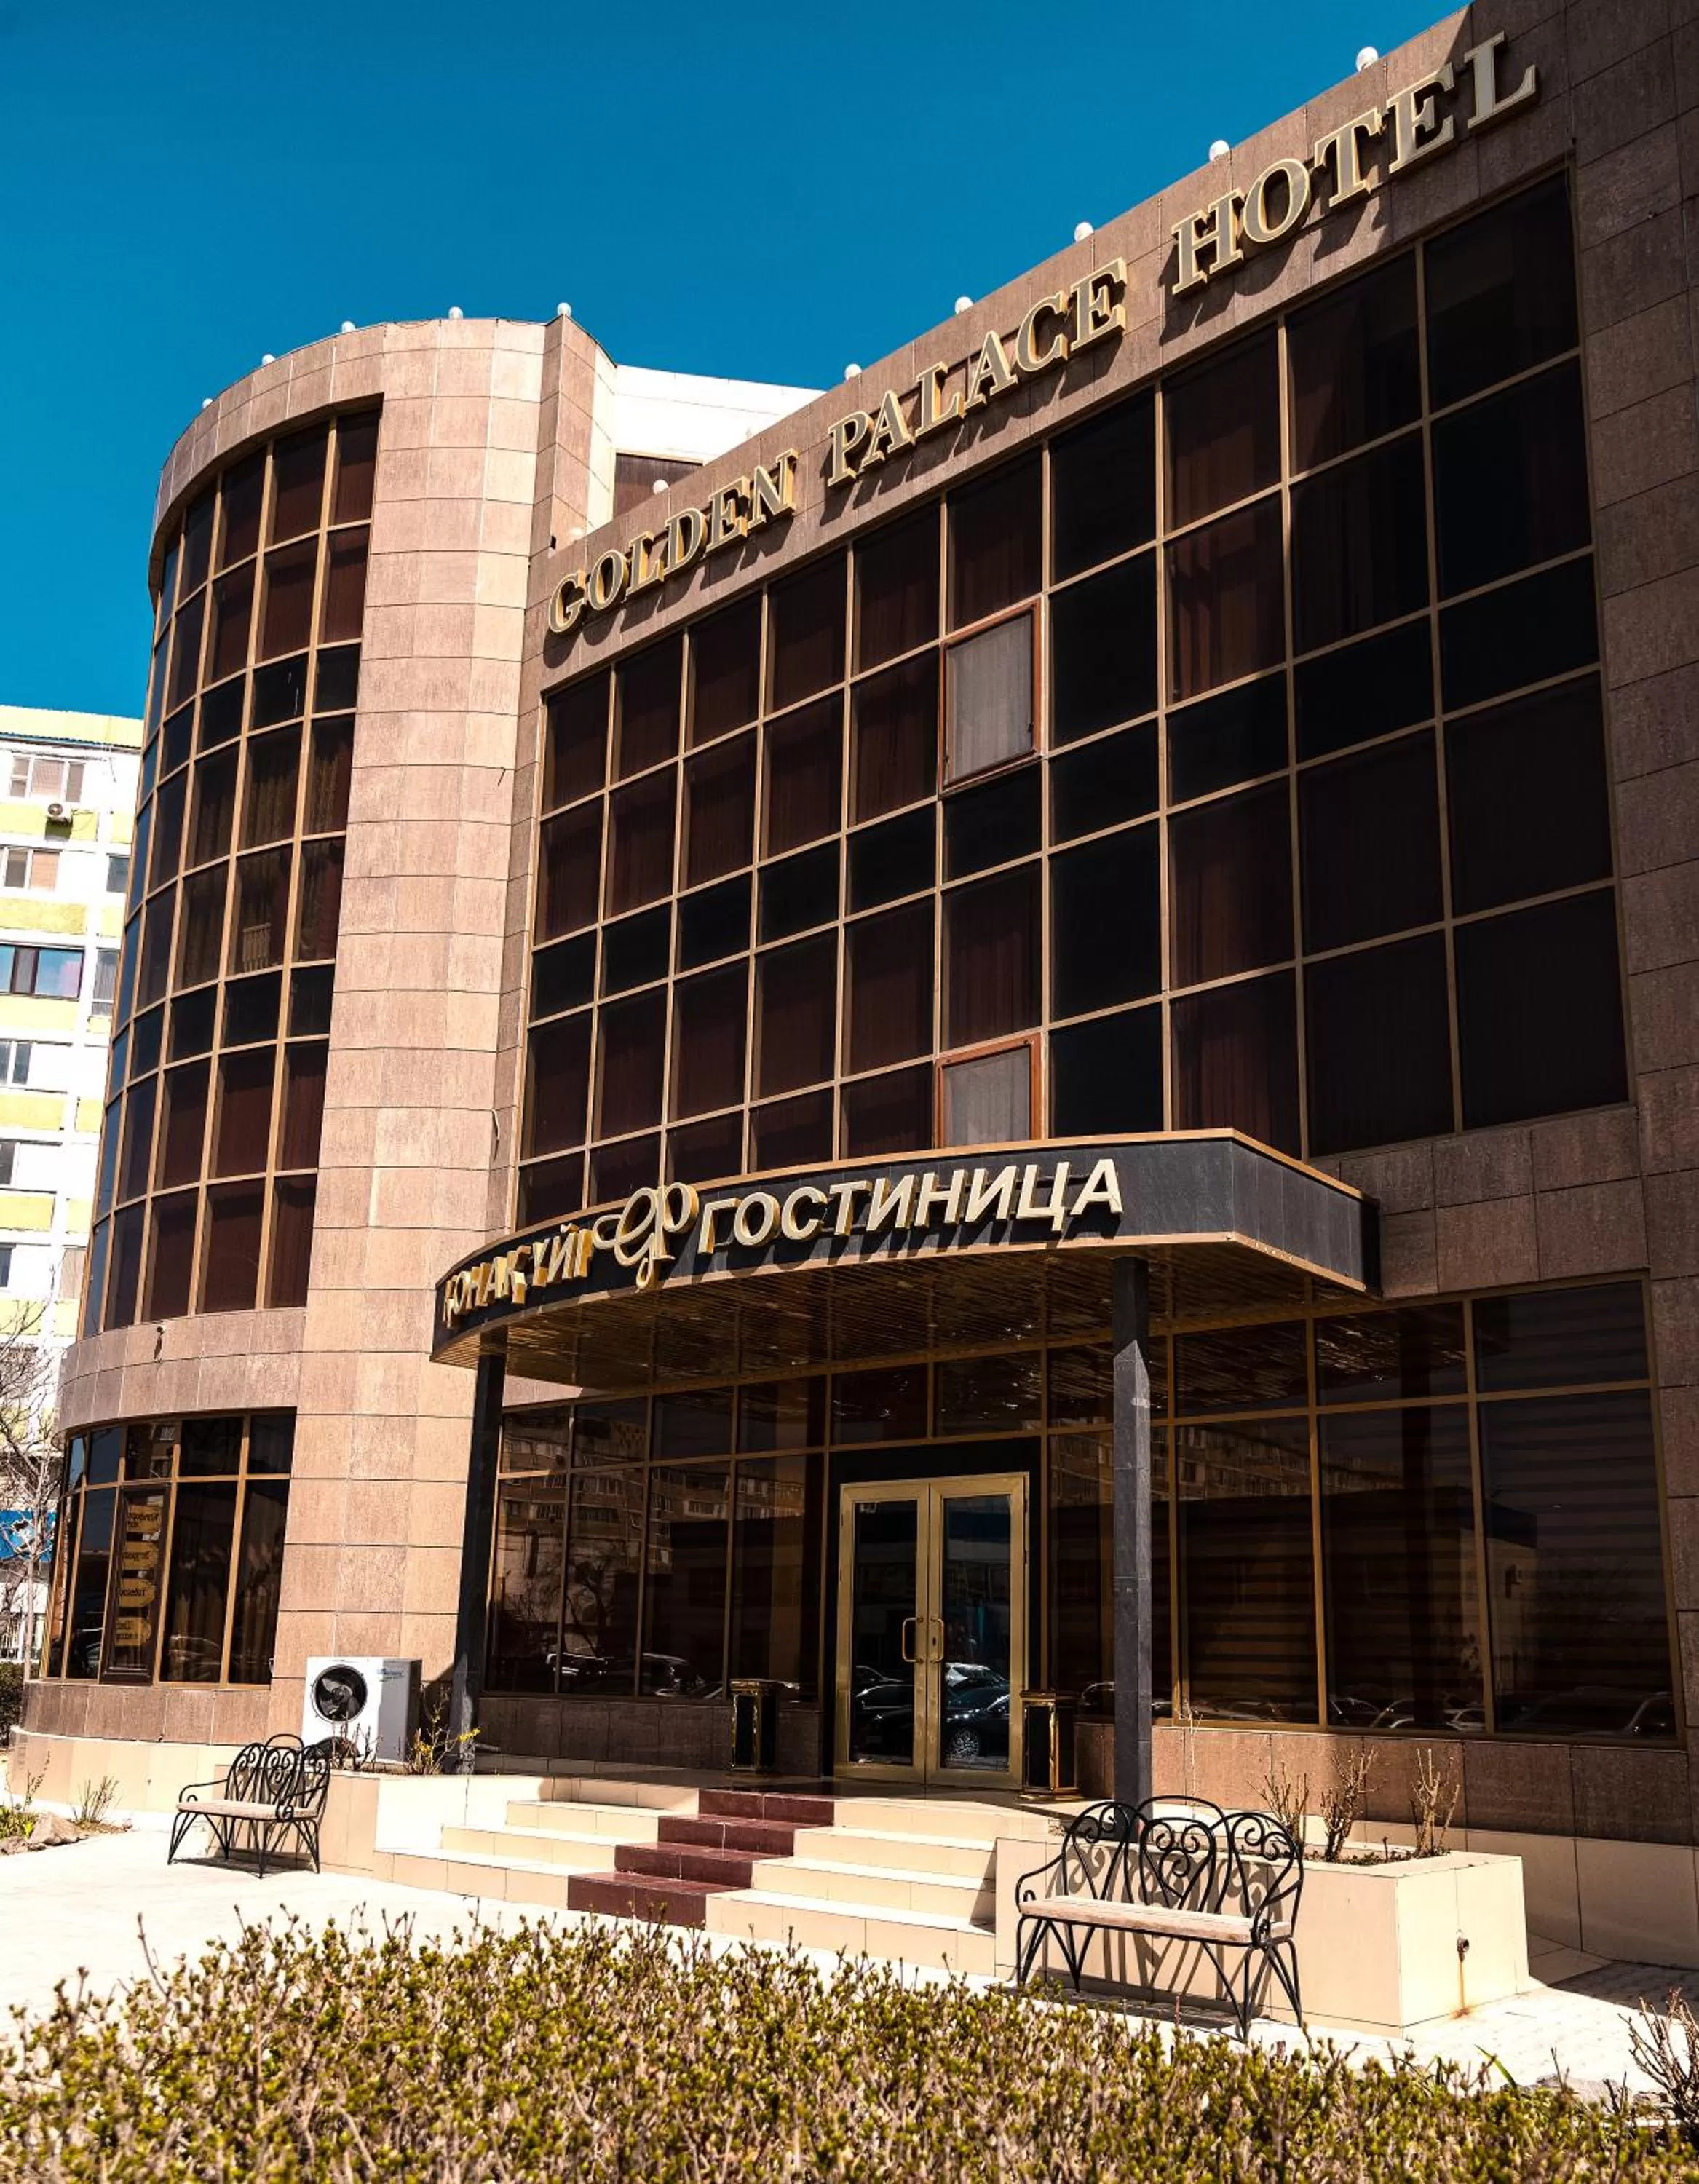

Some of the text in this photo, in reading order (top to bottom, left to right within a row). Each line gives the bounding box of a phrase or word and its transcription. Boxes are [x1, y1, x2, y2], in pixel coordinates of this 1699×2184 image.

[548, 31, 1537, 634] GOLDEN PALACE HOTEL
[697, 1158, 1123, 1254] ГОСТИНИЦА
